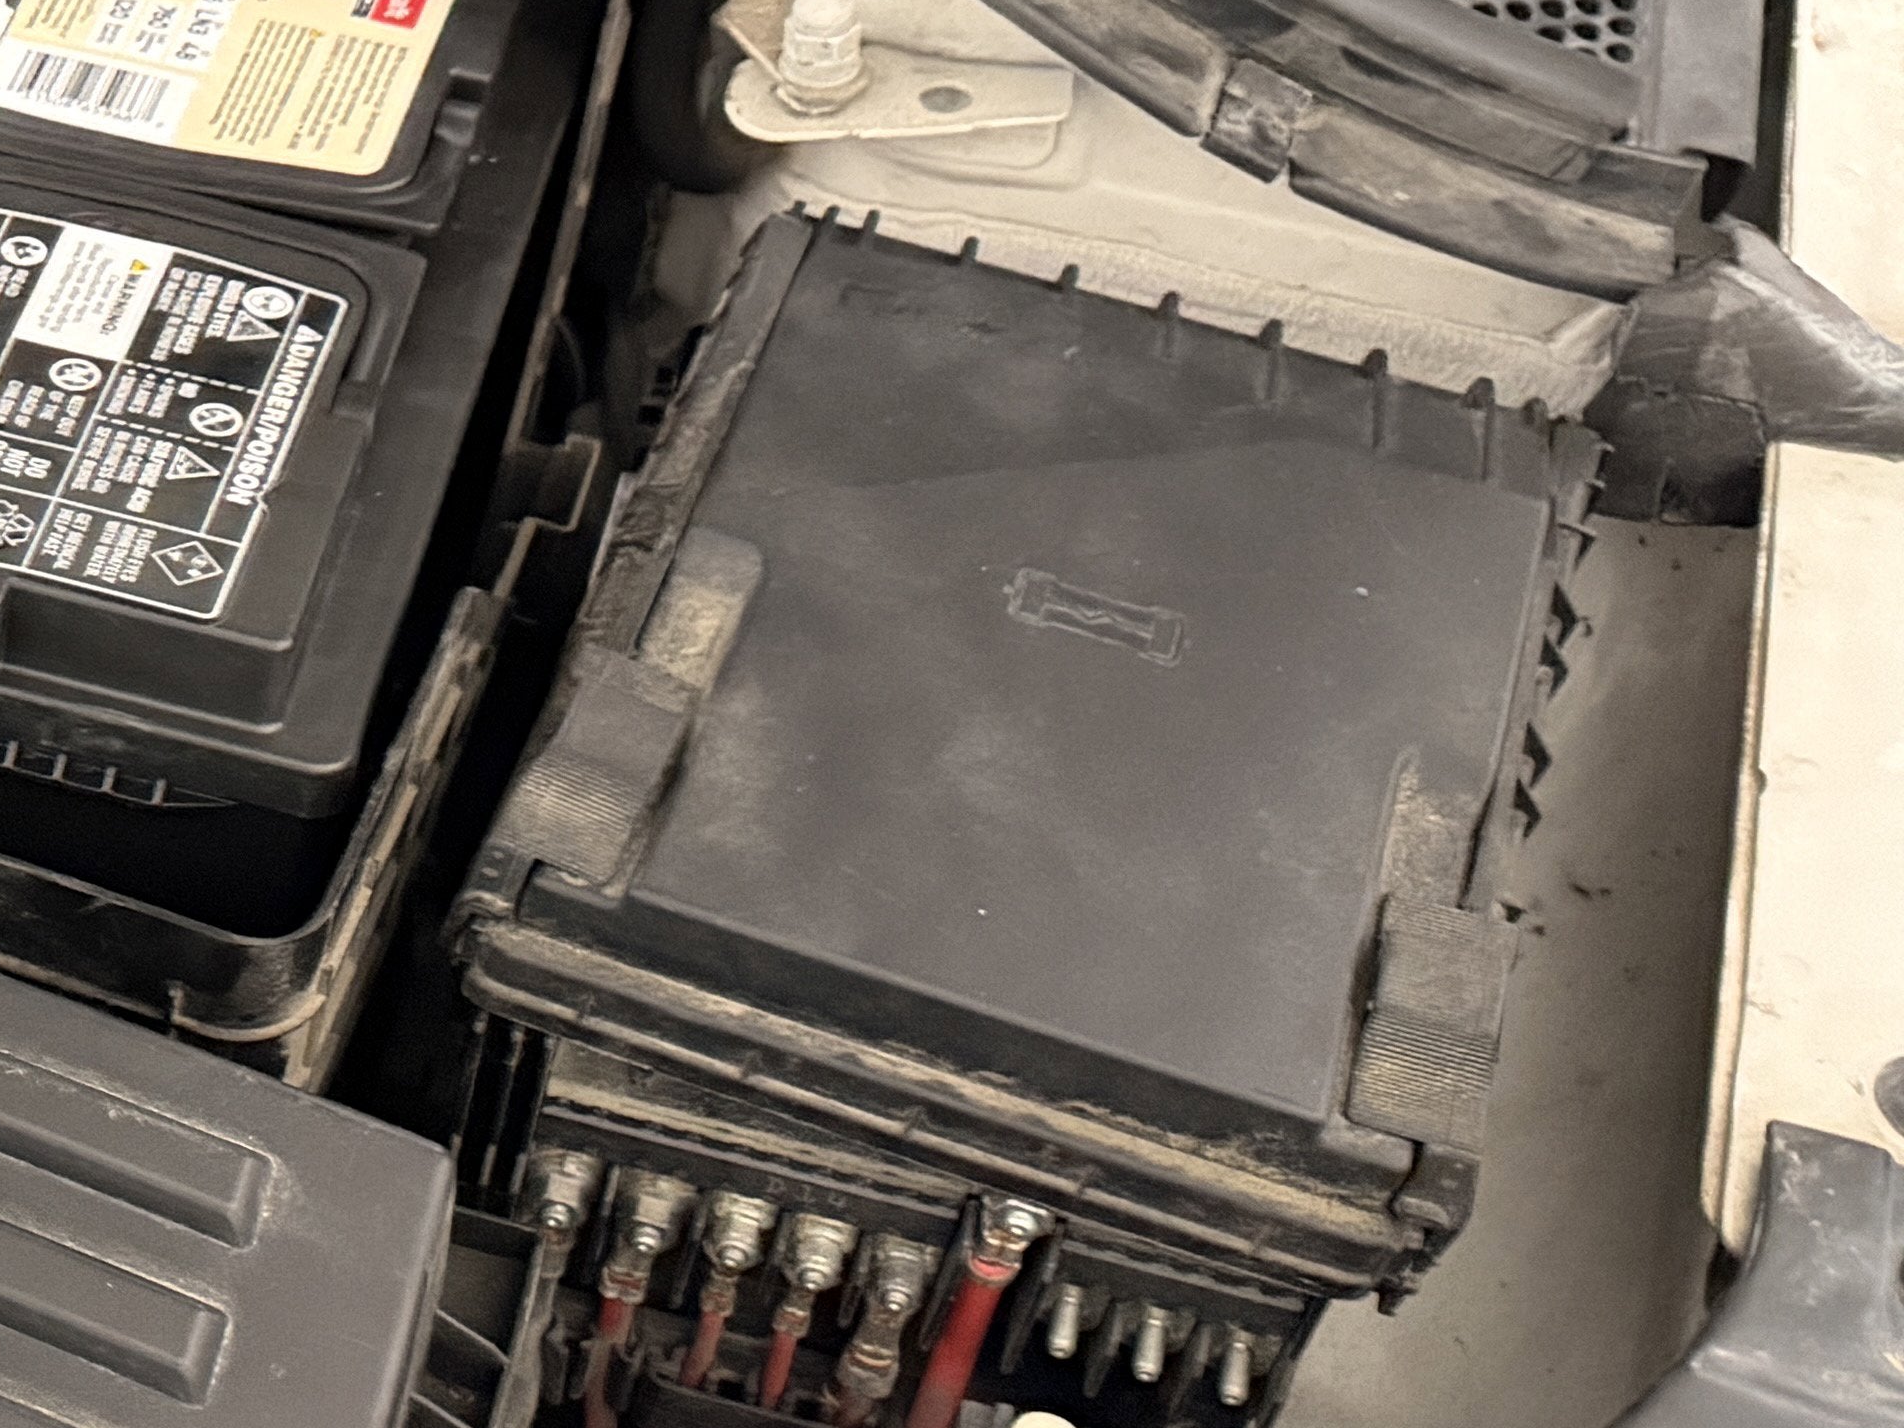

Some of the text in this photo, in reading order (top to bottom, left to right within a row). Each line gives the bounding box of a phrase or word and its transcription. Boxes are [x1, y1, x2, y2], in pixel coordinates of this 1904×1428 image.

[100, 272, 141, 335] WARNING:
[226, 342, 313, 504] DANGER/POISON
[22, 456, 51, 479] DO
